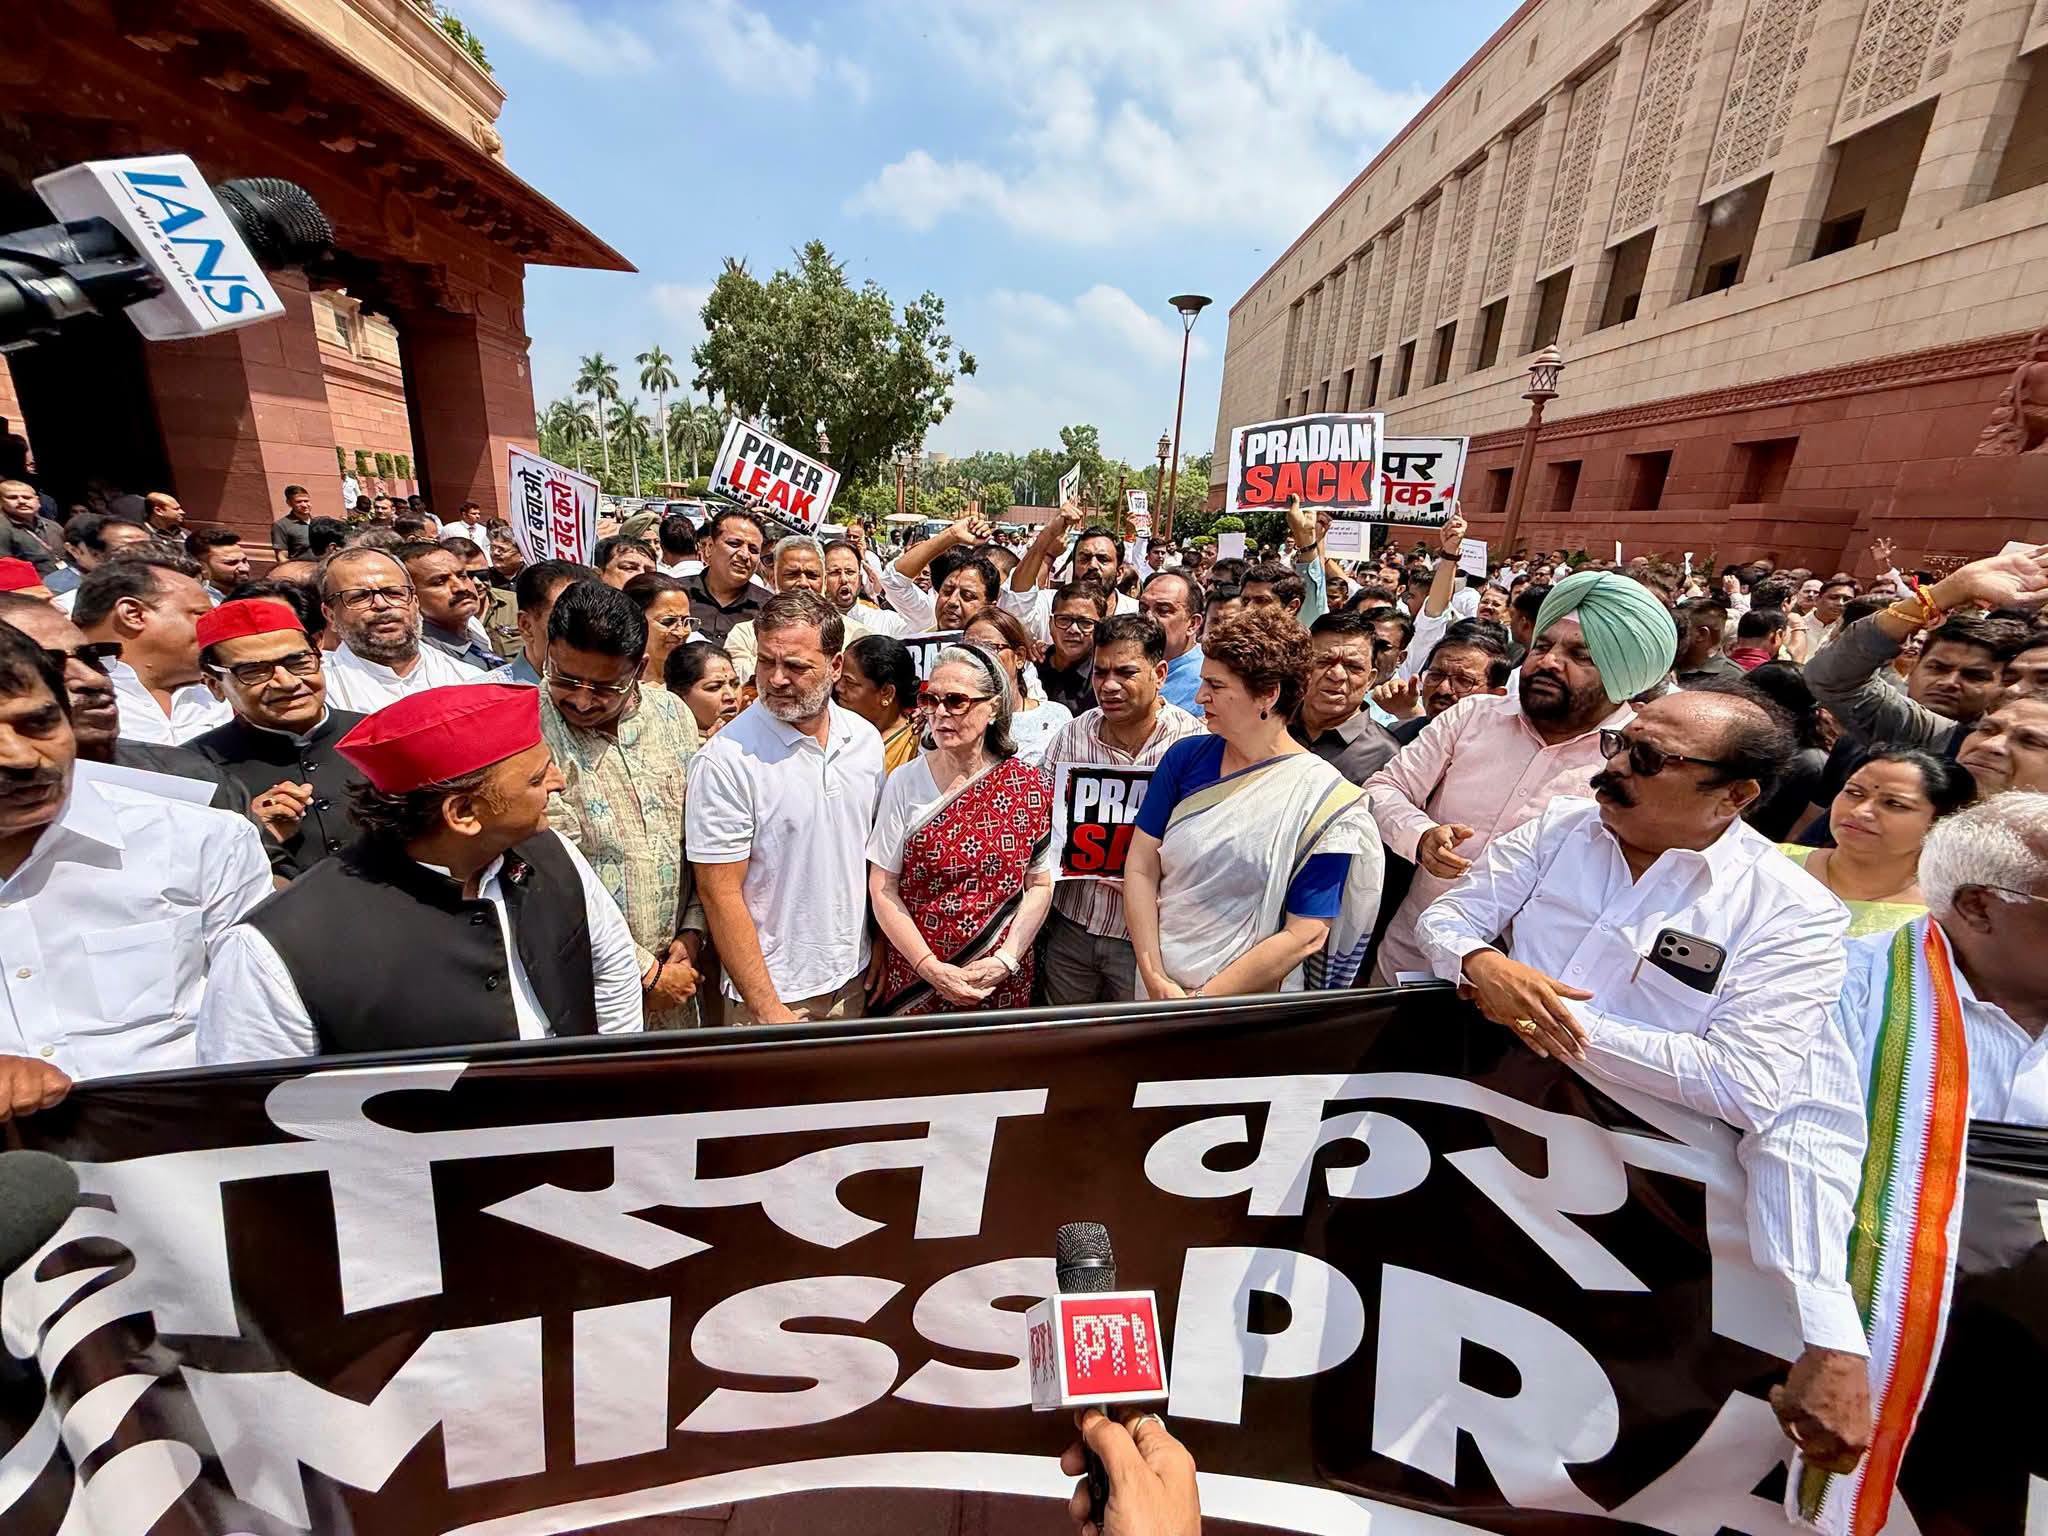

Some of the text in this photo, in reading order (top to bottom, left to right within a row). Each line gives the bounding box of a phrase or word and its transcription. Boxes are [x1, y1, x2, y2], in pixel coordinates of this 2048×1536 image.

[123, 170, 266, 316] IANS
[739, 432, 823, 495] PAPER
[1246, 424, 1372, 467] PRADAN
[1382, 453, 1443, 481] पर
[545, 479, 573, 516] करो
[729, 459, 817, 522] LEAK
[1245, 461, 1372, 504] SACK
[1381, 473, 1437, 506] ीक
[1074, 777, 1150, 824] PRA
[1071, 824, 1136, 871] SA
[1073, 1313, 1152, 1379] PTI
[180, 1247, 1925, 1536] MISS PRA
